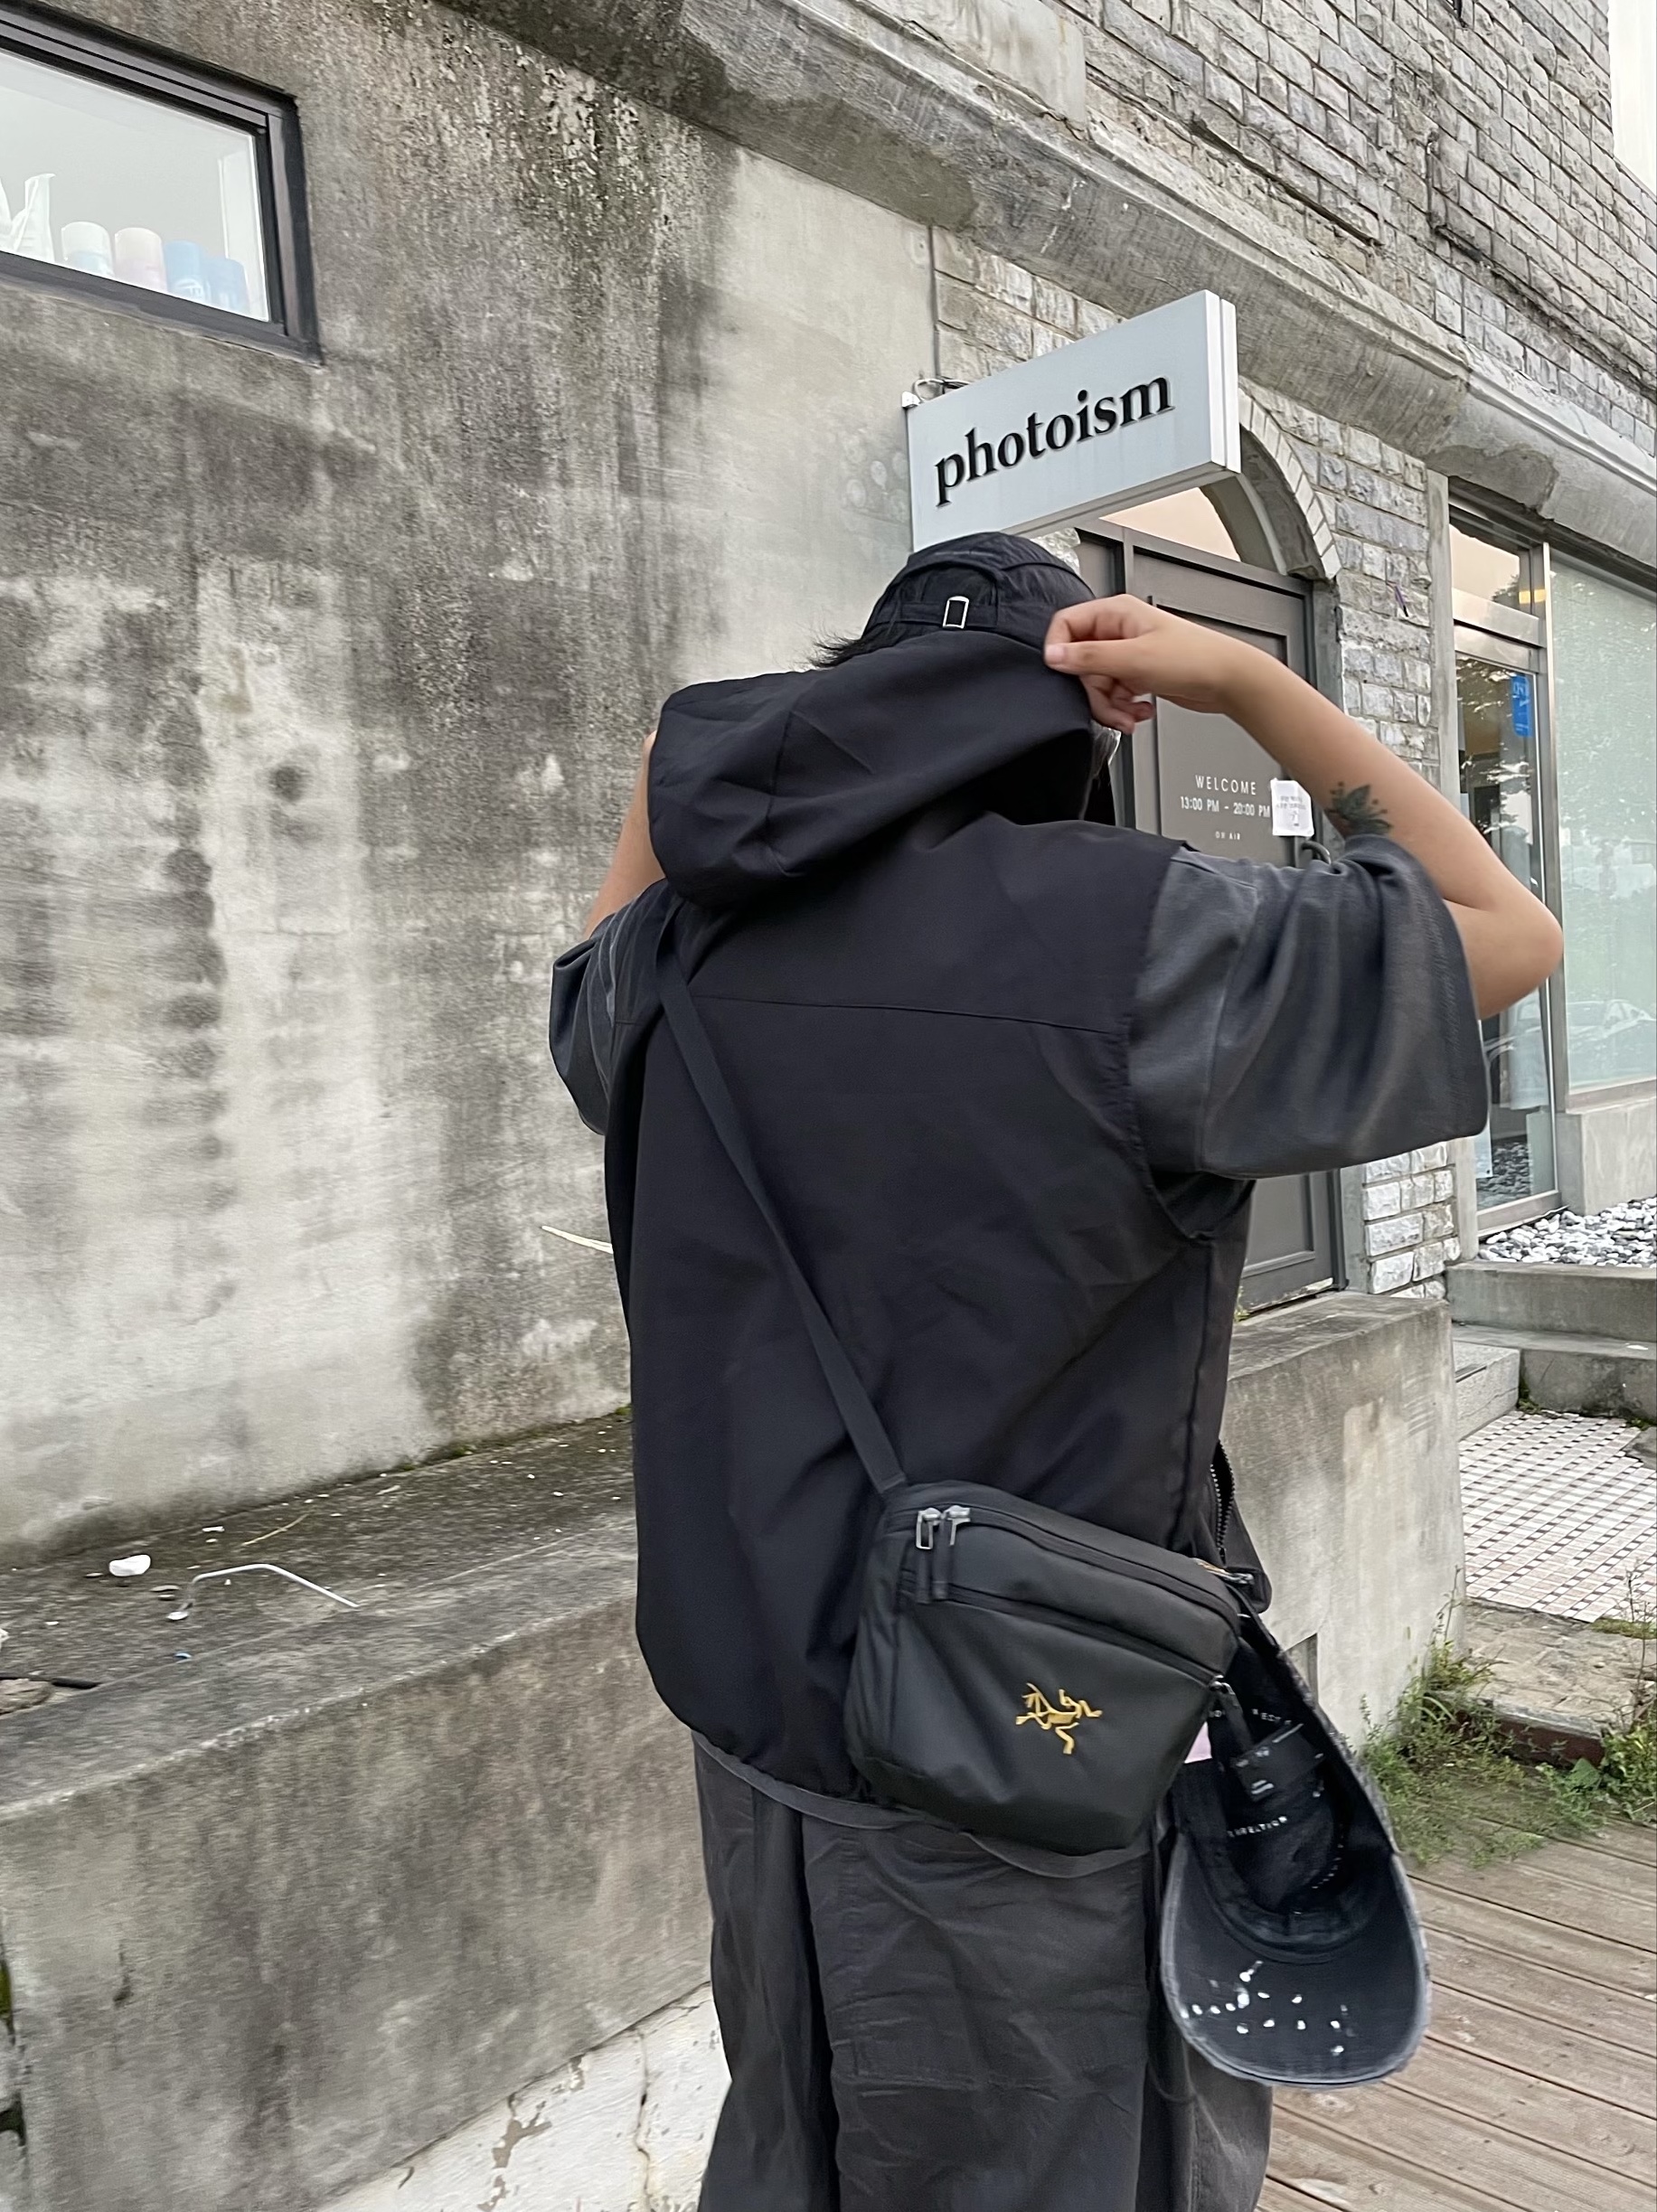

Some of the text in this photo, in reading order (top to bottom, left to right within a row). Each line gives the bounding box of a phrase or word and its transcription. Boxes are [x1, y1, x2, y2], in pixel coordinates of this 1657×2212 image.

[934, 376, 1173, 507] photoism
[1195, 775, 1257, 795] WELCOME
[1181, 795, 1203, 811] 13:00
[1207, 798, 1219, 813] PM
[1258, 805, 1271, 818] PM
